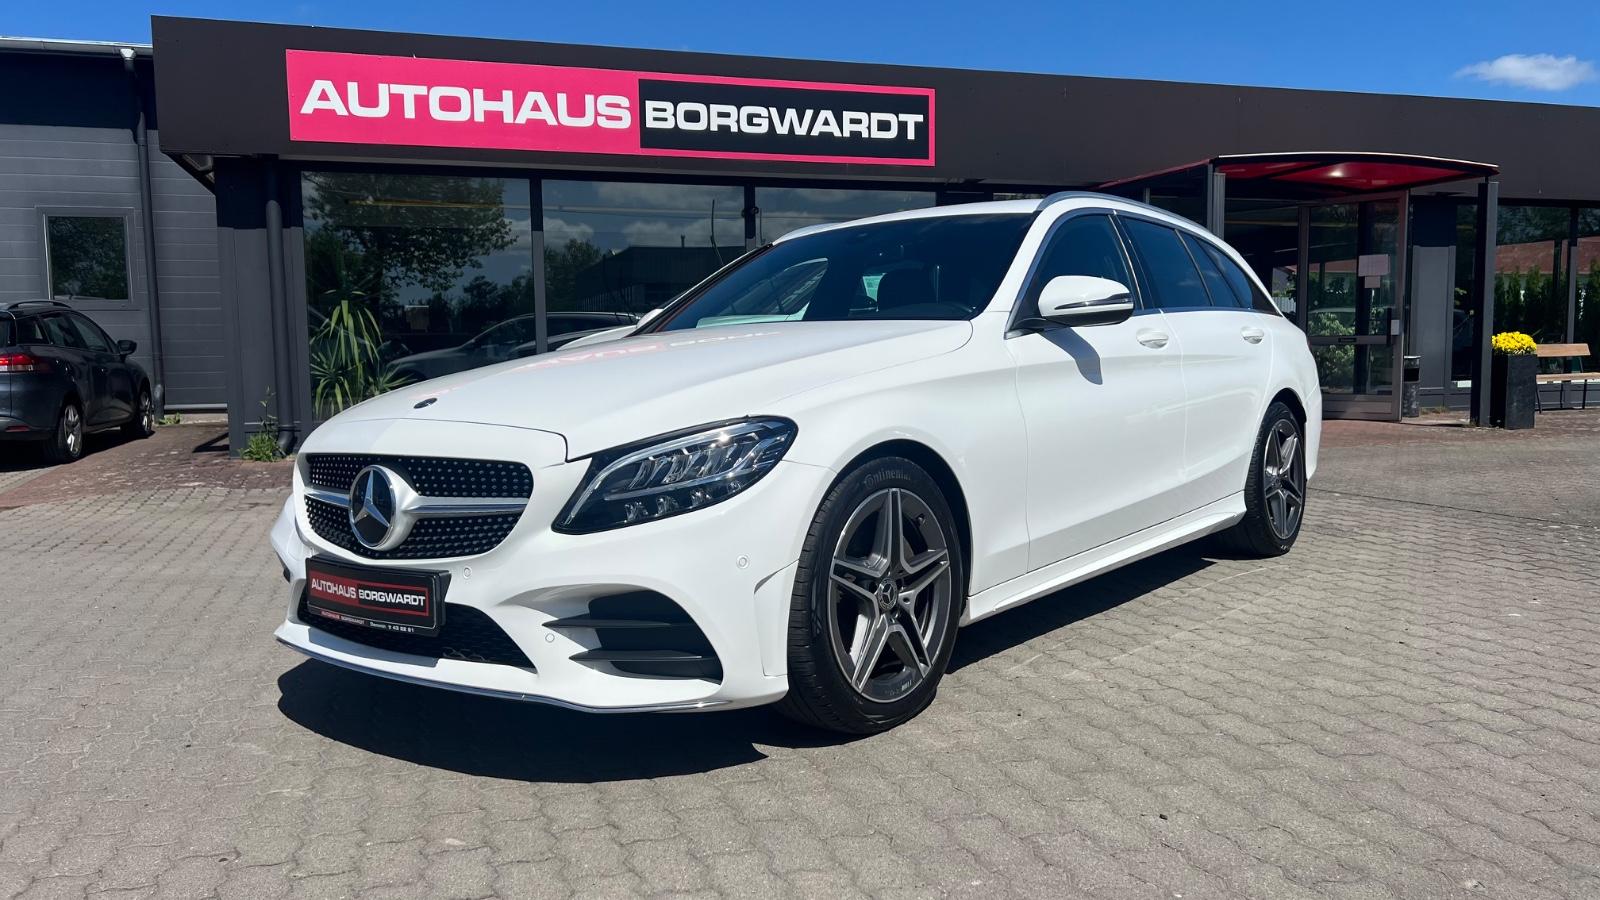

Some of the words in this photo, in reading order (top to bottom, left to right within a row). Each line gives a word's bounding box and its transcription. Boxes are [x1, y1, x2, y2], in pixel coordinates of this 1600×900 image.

[300, 79, 631, 129] AUTOHAUS
[645, 100, 924, 140] BORGWARDT
[311, 578, 356, 598] AUTOHAUS
[358, 589, 426, 605] BORGWARDT
